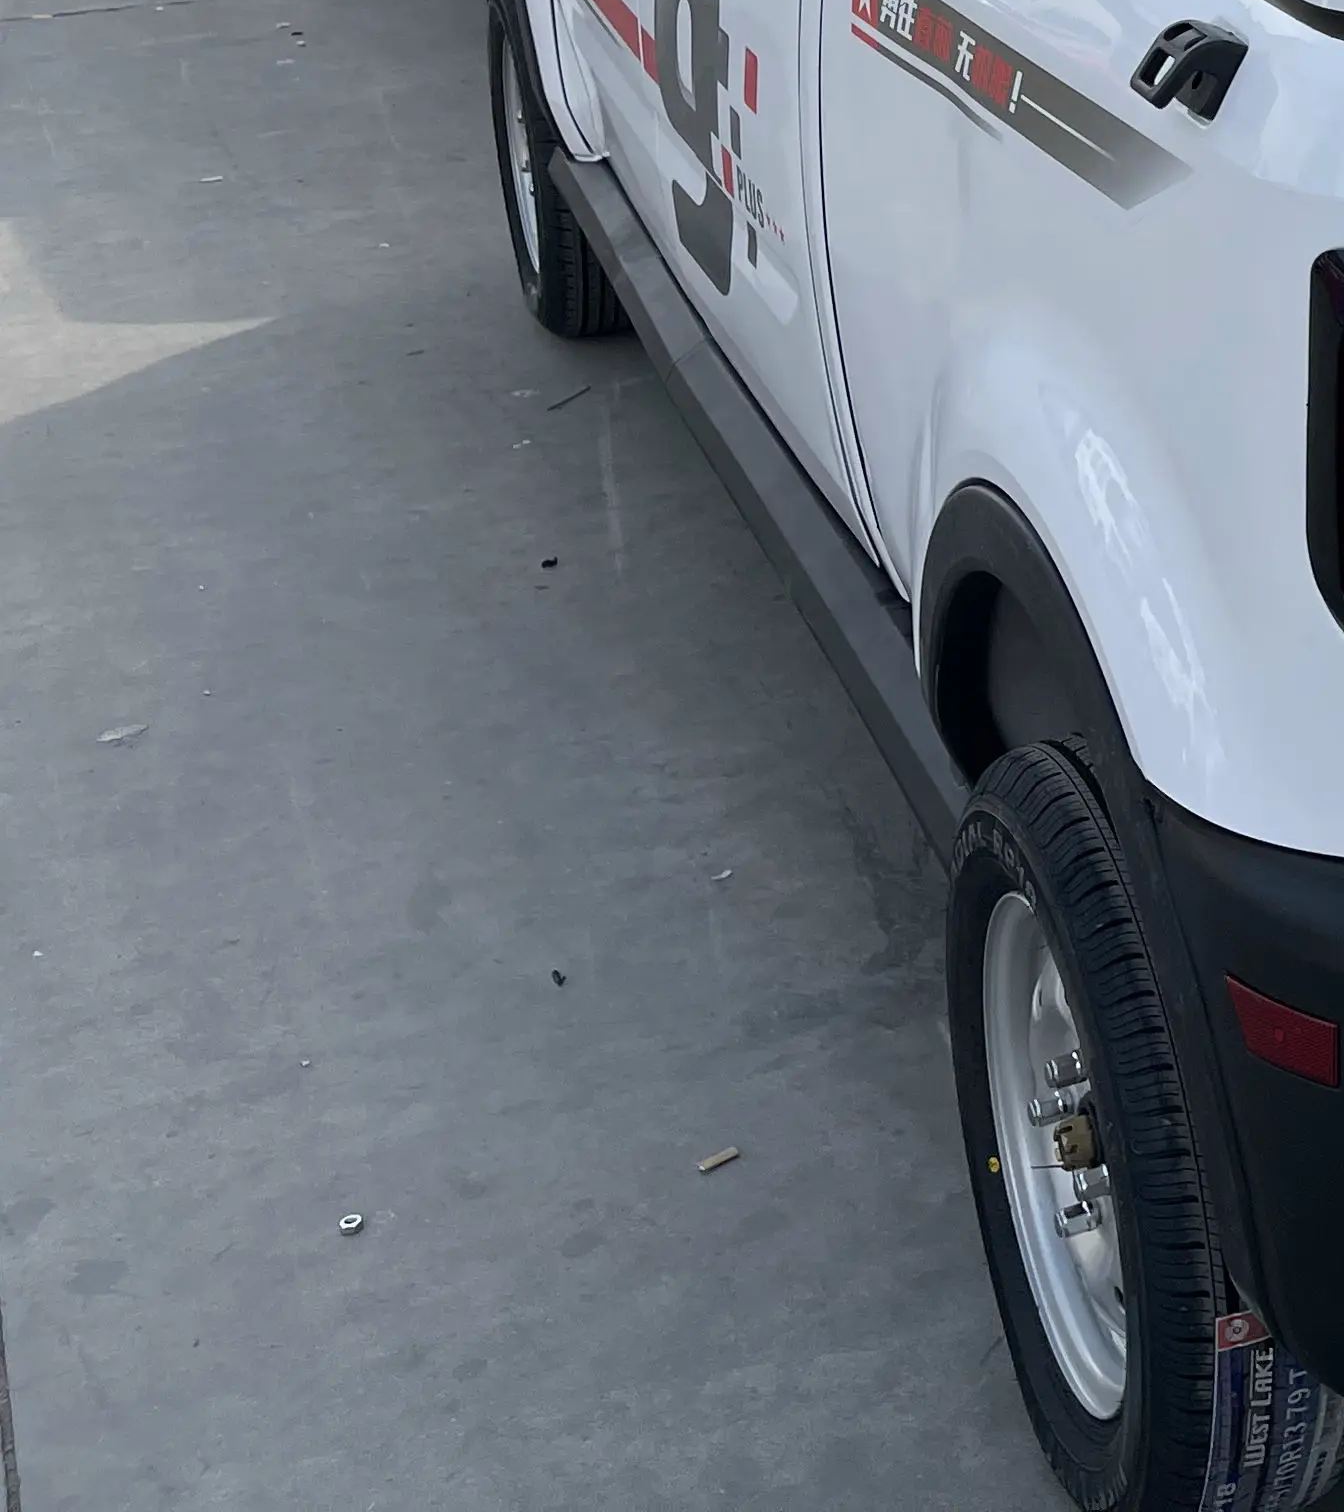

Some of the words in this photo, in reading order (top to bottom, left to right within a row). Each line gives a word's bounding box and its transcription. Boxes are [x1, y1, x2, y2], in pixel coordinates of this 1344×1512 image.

[735, 164, 765, 229] PLUS
[1250, 1346, 1275, 1408] LAKE
[1286, 1387, 1312, 1420] 79
[1242, 1411, 1272, 1468] WEST
